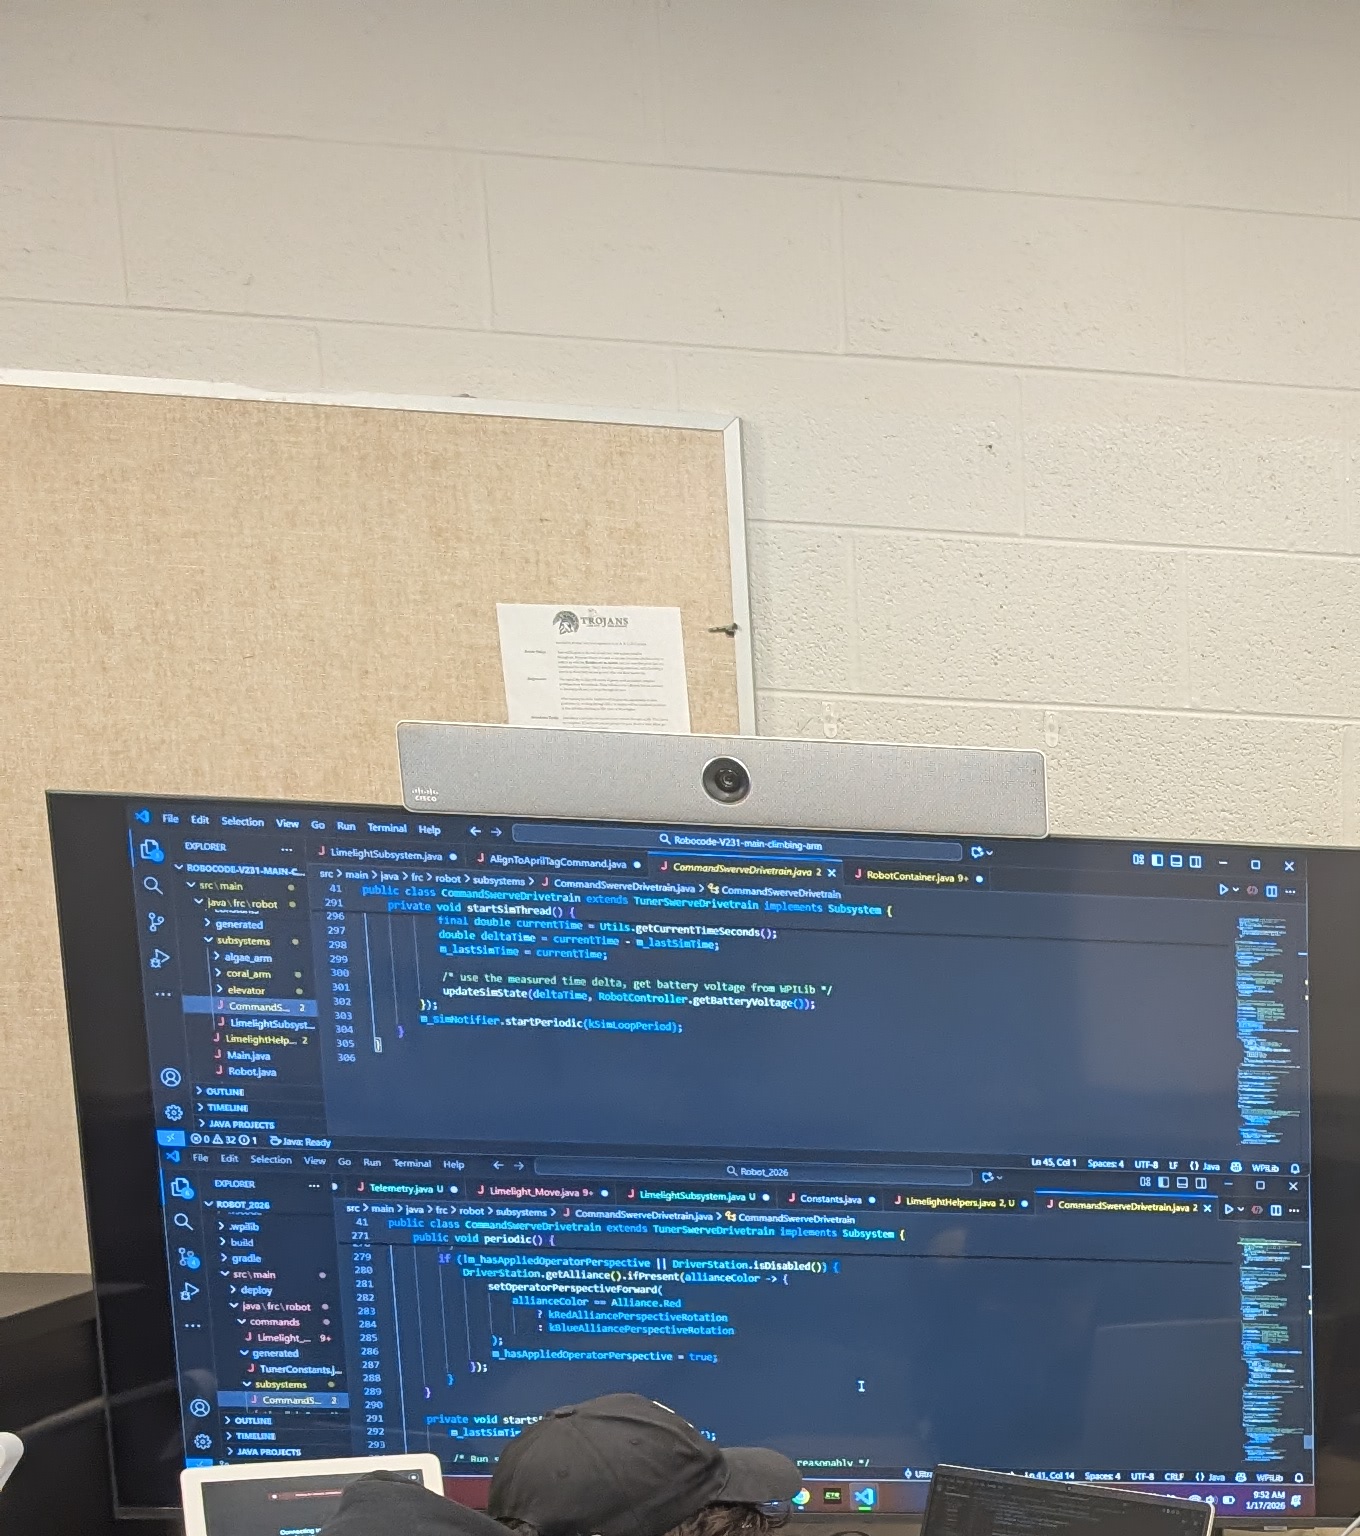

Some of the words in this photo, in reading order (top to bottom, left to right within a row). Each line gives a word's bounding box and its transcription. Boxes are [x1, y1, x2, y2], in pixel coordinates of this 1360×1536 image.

[581, 617, 628, 627] TROJANS
[163, 815, 179, 823] File
[191, 815, 209, 824] Edit
[222, 817, 264, 827] Selection
[276, 819, 299, 828] View
[311, 821, 325, 830] Go
[338, 822, 356, 831] Run
[368, 823, 407, 833] Terminal
[419, 825, 441, 836] Help
[673, 863, 812, 878] CommandSwerveDrivetrain.java
[867, 871, 954, 883] RobotContainer.java
[320, 870, 333, 878] src
[346, 871, 368, 879] main
[381, 873, 399, 882] java
[436, 875, 461, 883] robot
[473, 876, 525, 886] subsystems
[555, 880, 695, 894] CommandSwerveDrivetrain.java
[722, 886, 841, 899] CommandSwerveDrivetrain
[361, 886, 399, 895] public
[405, 887, 435, 896] class
[441, 888, 580, 902] CommandSwerveDrivetrain
[587, 895, 628, 904] extends
[634, 897, 759, 910] TunerSwerveDrivetrain
[764, 902, 822, 912] implements
[829, 905, 882, 915] Subsystem
[388, 901, 431, 911] private
[437, 902, 461, 911] void
[467, 904, 562, 917] startSimThread()
[216, 919, 263, 931] generated
[438, 916, 468, 925] final
[474, 917, 511, 927] double
[516, 918, 583, 930] currentTime
[217, 936, 270, 948] subsystems
[439, 930, 475, 940] double
[481, 932, 535, 942] deltaTime
[553, 936, 619, 945] currentTime
[536, 948, 607, 960] currentTime;
[460, 974, 478, 982] use
[484, 973, 502, 983] the
[508, 974, 556, 985] measured
[562, 977, 586, 986] time
[592, 978, 627, 989] delta,
[633, 980, 651, 990] get
[657, 981, 698, 992] battery
[704, 982, 745, 993] voltage
[751, 984, 775, 992] from
[228, 986, 266, 996] elevator
[193, 1154, 208, 1162] File
[221, 1155, 239, 1163] Edit
[251, 1156, 292, 1166] Selection
[304, 1156, 326, 1166] View
[338, 1158, 351, 1166] Go
[364, 1159, 381, 1167] Run
[394, 1159, 431, 1169] Terminal
[443, 1160, 465, 1171] Help
[1203, 1163, 1220, 1171] Java
[459, 1207, 484, 1215] robot
[496, 1209, 547, 1217] subsystems
[575, 1210, 713, 1222] CommandSwerveDrivetrain.java
[739, 1214, 855, 1224] CommandSwerveDrivetrain
[388, 1218, 424, 1228] public
[431, 1219, 459, 1228] class
[465, 1221, 601, 1232] CommandSwerveDrivetrain
[607, 1224, 647, 1233] extends
[653, 1225, 774, 1236] TunerSwerveDrivetrain
[781, 1228, 837, 1238] implements
[842, 1228, 894, 1240] Subsystem
[231, 1238, 253, 1247] build
[413, 1233, 448, 1243] public
[455, 1234, 479, 1242] void
[484, 1235, 543, 1246] periodic()
[241, 1286, 272, 1295] deploy
[513, 1296, 589, 1306] allianceColor
[611, 1299, 681, 1307] Alliance.Red
[250, 1318, 299, 1326] commands
[253, 1349, 299, 1359] generated
[255, 1380, 307, 1389] subsystems
[1254, 1491, 1268, 1499] 9:52
[1246, 1501, 1285, 1510] 1/17/2026
